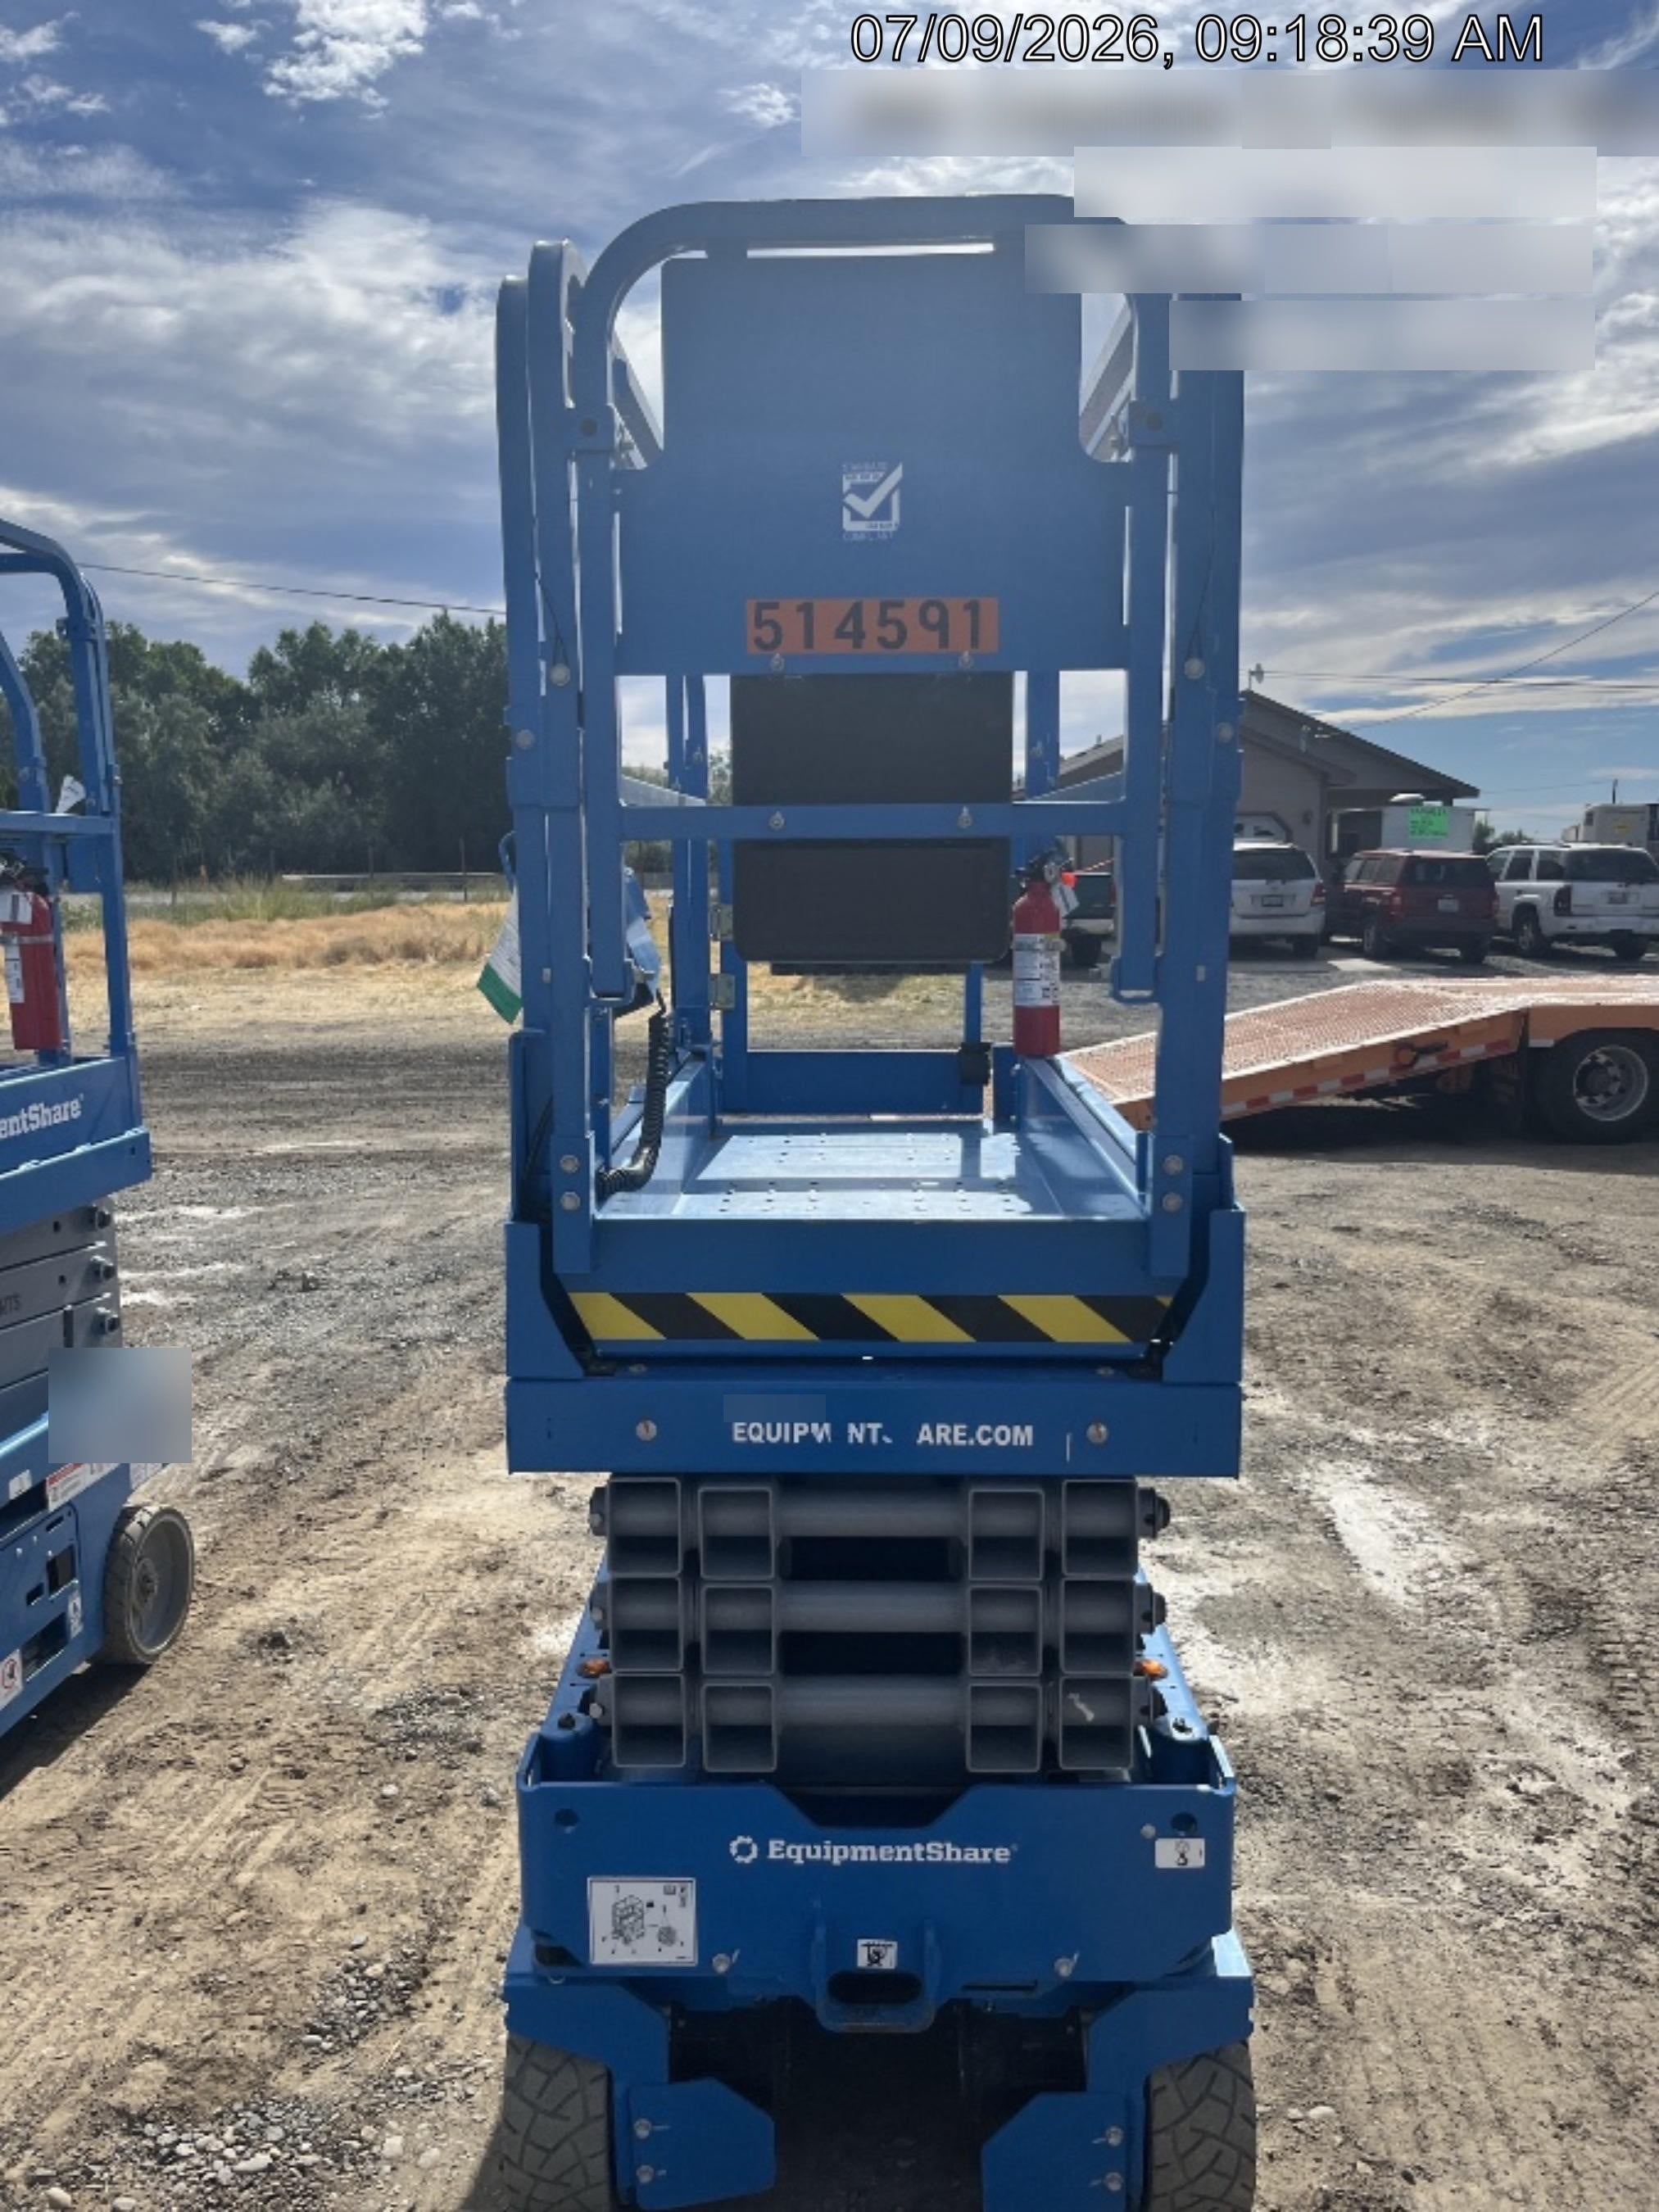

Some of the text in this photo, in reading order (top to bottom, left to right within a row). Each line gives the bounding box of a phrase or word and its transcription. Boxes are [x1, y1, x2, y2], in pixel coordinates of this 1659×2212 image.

[753, 599, 981, 651] 514591
[732, 1421, 1034, 1446] EQUIPMNTARE.COM
[767, 1839, 1012, 1865] EquipmentShare
